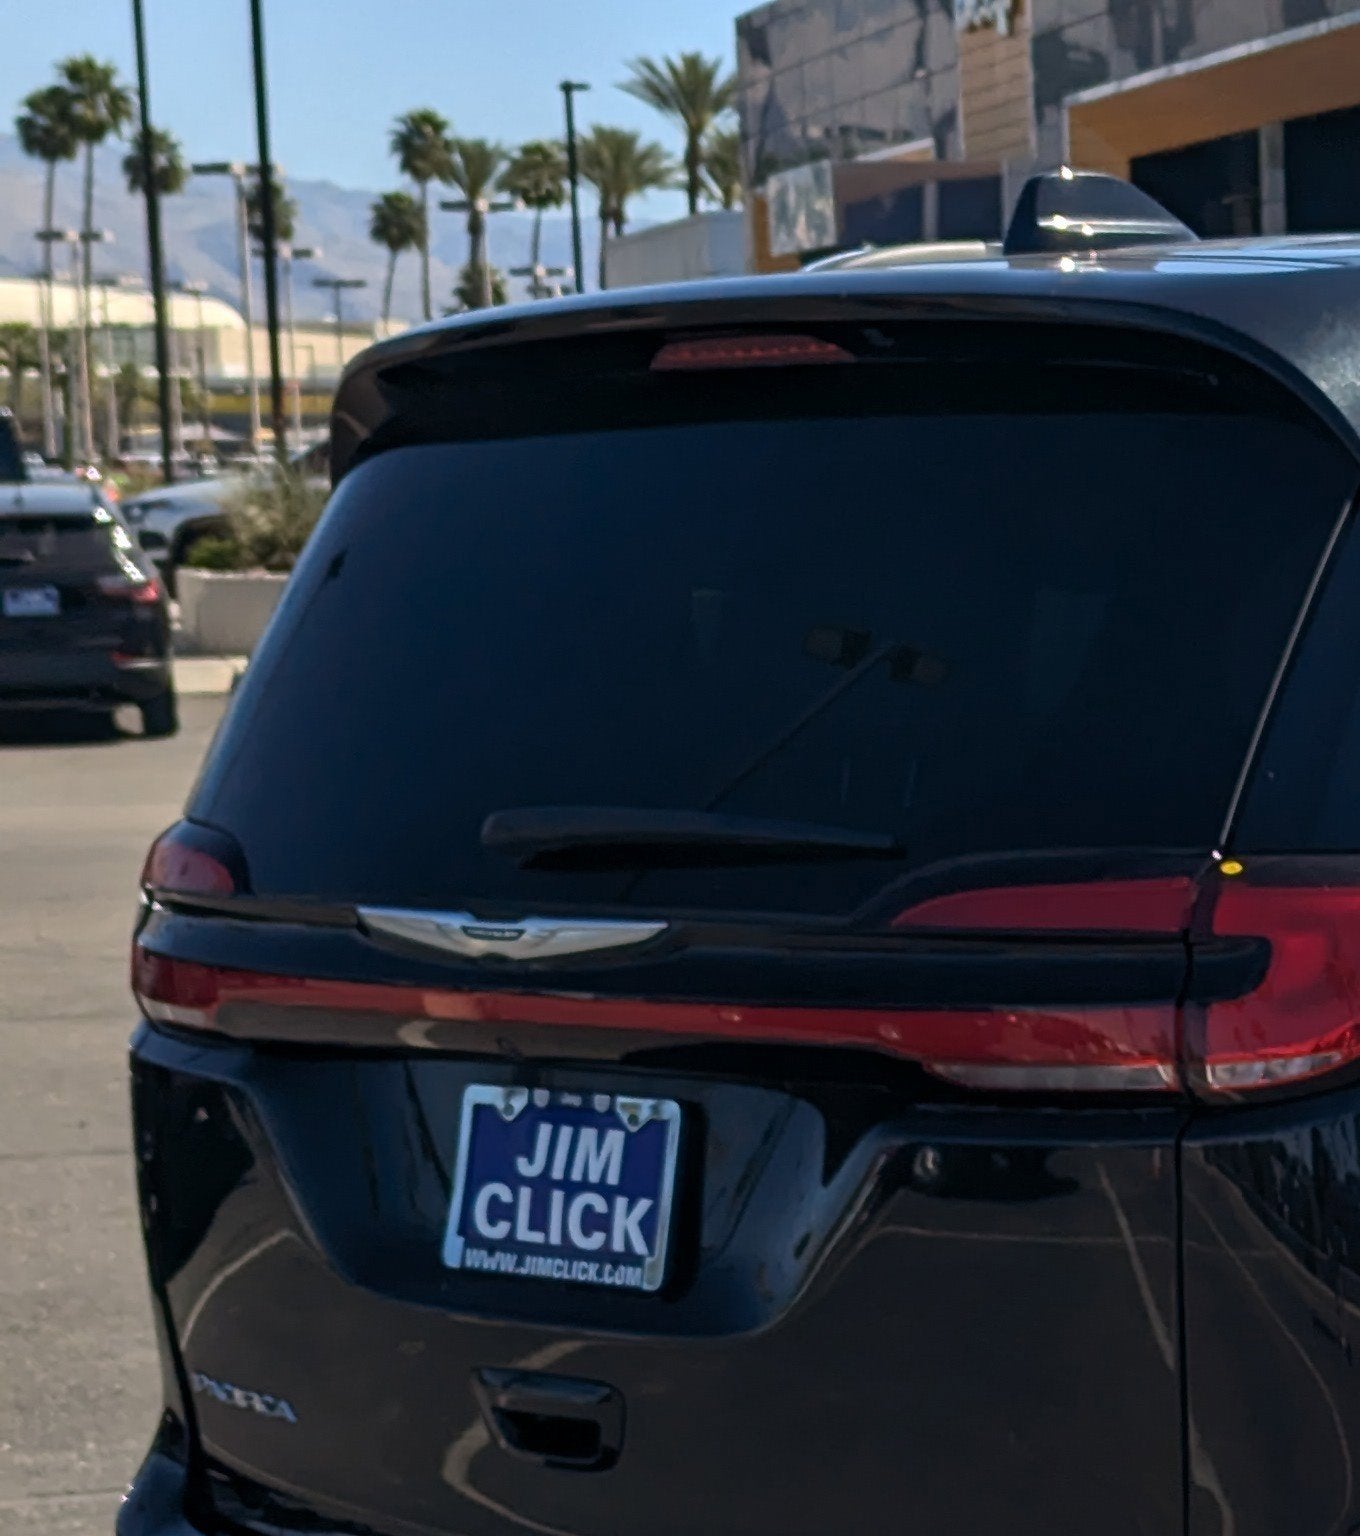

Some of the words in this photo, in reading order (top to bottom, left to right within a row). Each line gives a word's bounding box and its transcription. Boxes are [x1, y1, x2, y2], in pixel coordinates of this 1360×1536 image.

[516, 1121, 626, 1186] JIM
[473, 1181, 655, 1256] CLICK
[463, 1247, 643, 1287] WWW.JIMCLICK.COM
